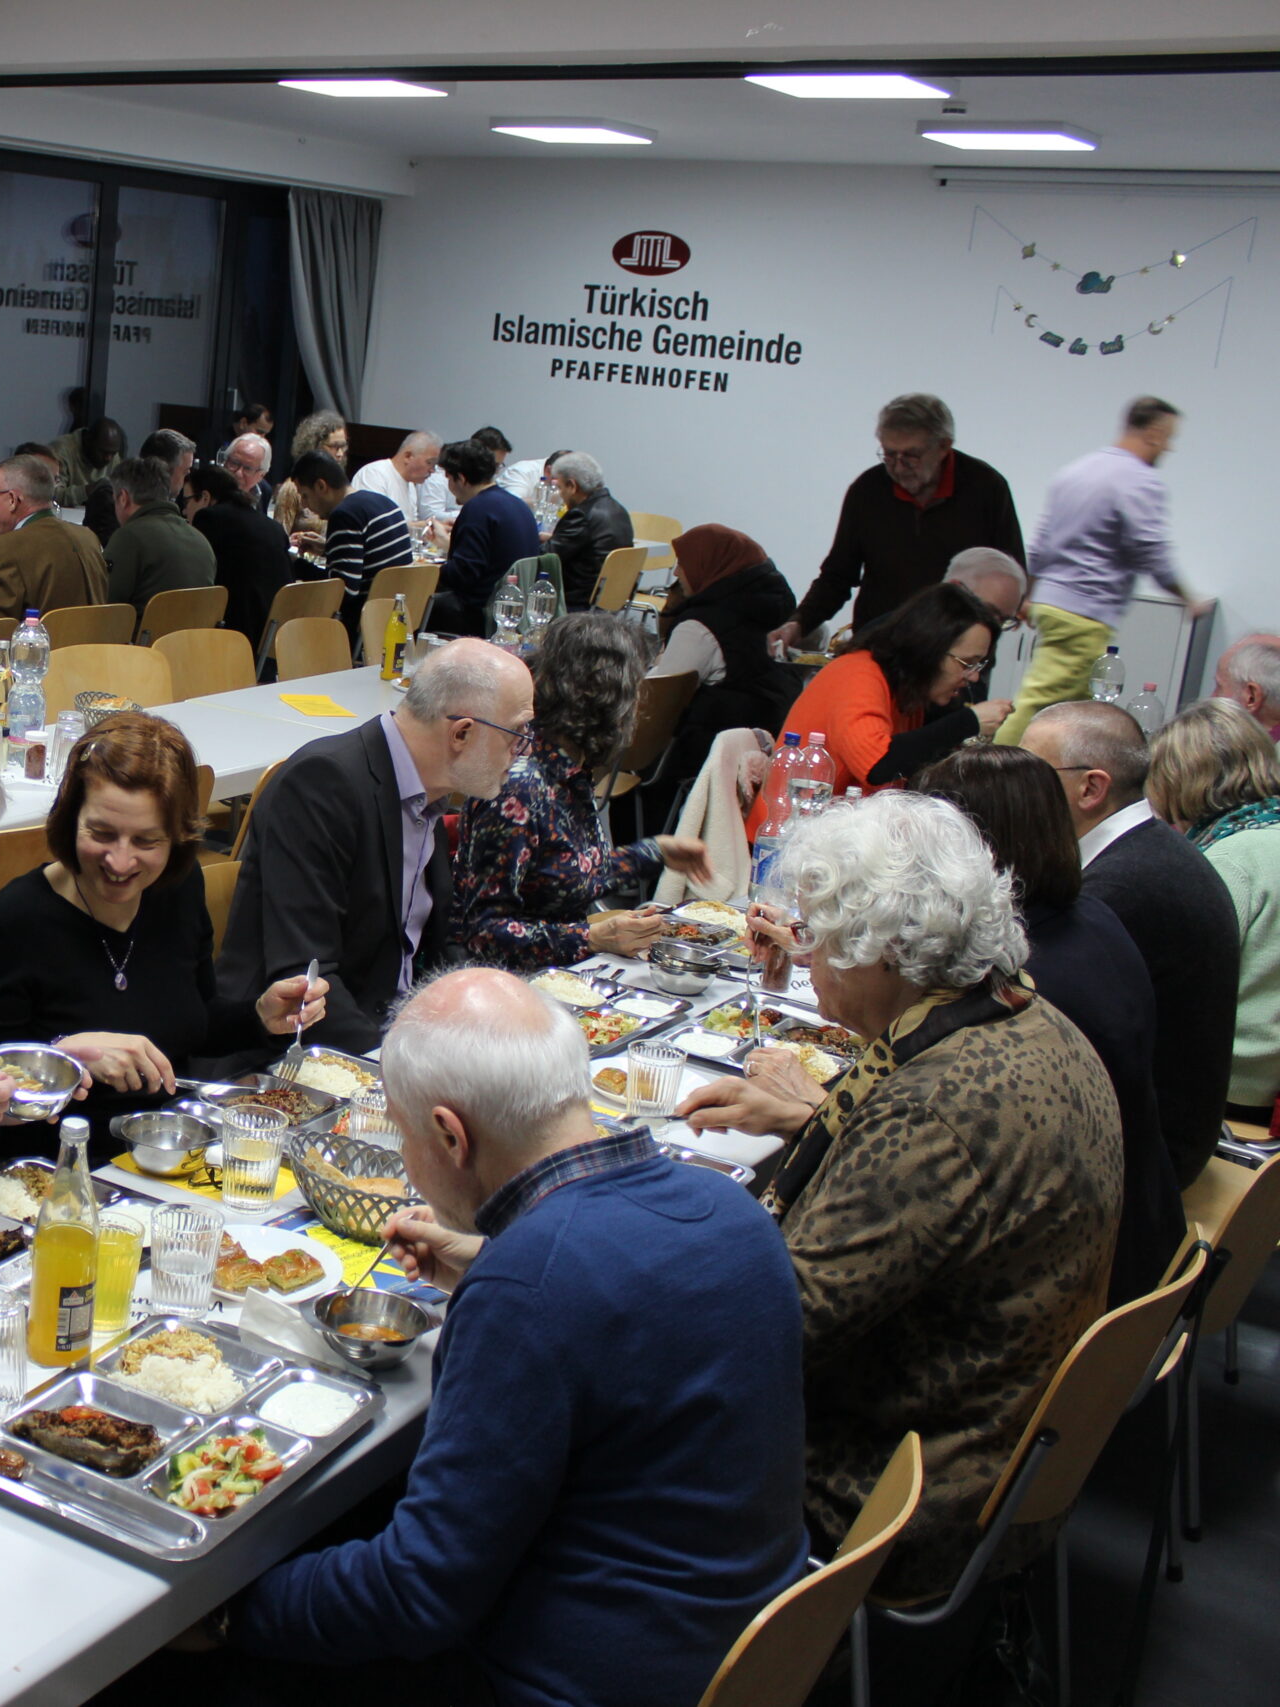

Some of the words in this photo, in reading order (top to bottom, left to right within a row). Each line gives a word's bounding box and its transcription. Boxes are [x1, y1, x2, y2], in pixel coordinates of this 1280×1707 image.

[583, 283, 710, 322] Türkisch
[492, 312, 643, 353] Islamische
[652, 323, 803, 365] Gemeinde
[550, 357, 730, 393] PFAFFENHOFEN
